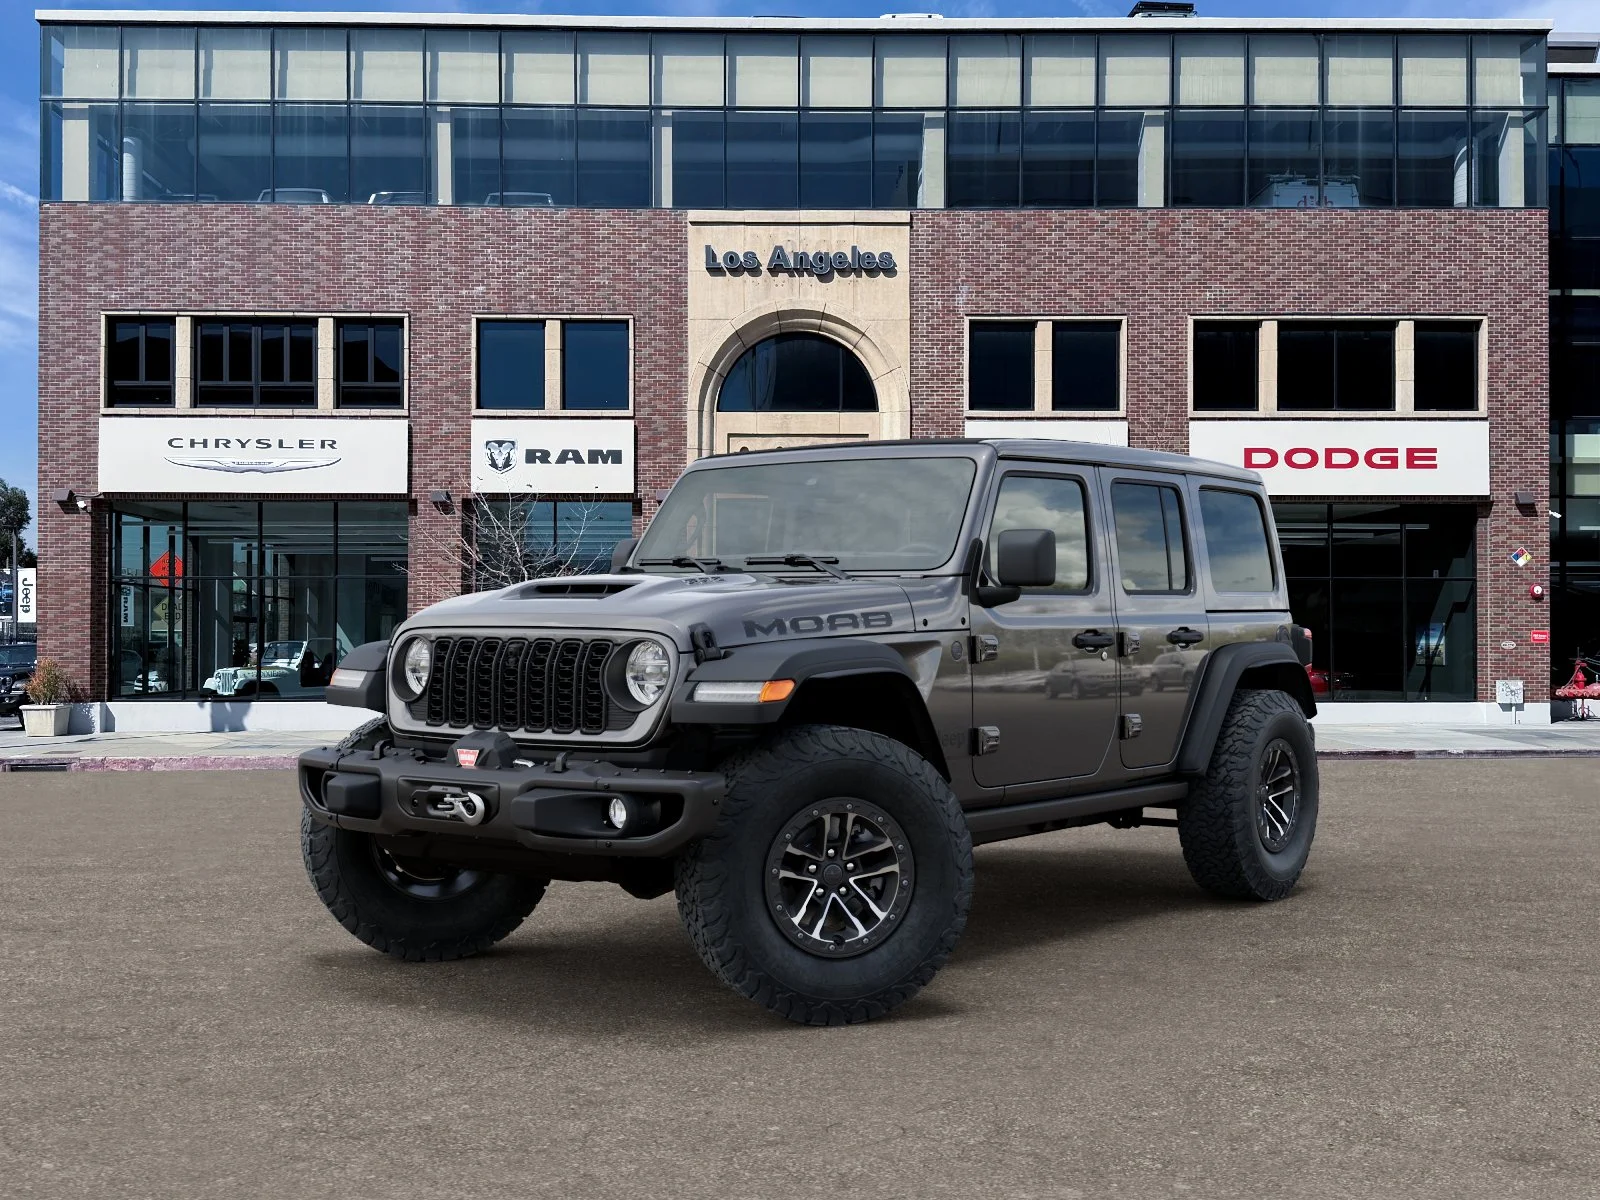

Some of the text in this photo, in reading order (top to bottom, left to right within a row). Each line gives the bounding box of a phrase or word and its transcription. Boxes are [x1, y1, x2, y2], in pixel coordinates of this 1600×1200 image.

[1297, 195, 1334, 207] dih
[705, 244, 895, 275] Los Angeles
[167, 437, 338, 449] CHRYSLER
[525, 449, 623, 464] RAM
[1244, 447, 1438, 469] DODGE
[20, 577, 33, 613] Jeep
[742, 611, 893, 638] MOAB
